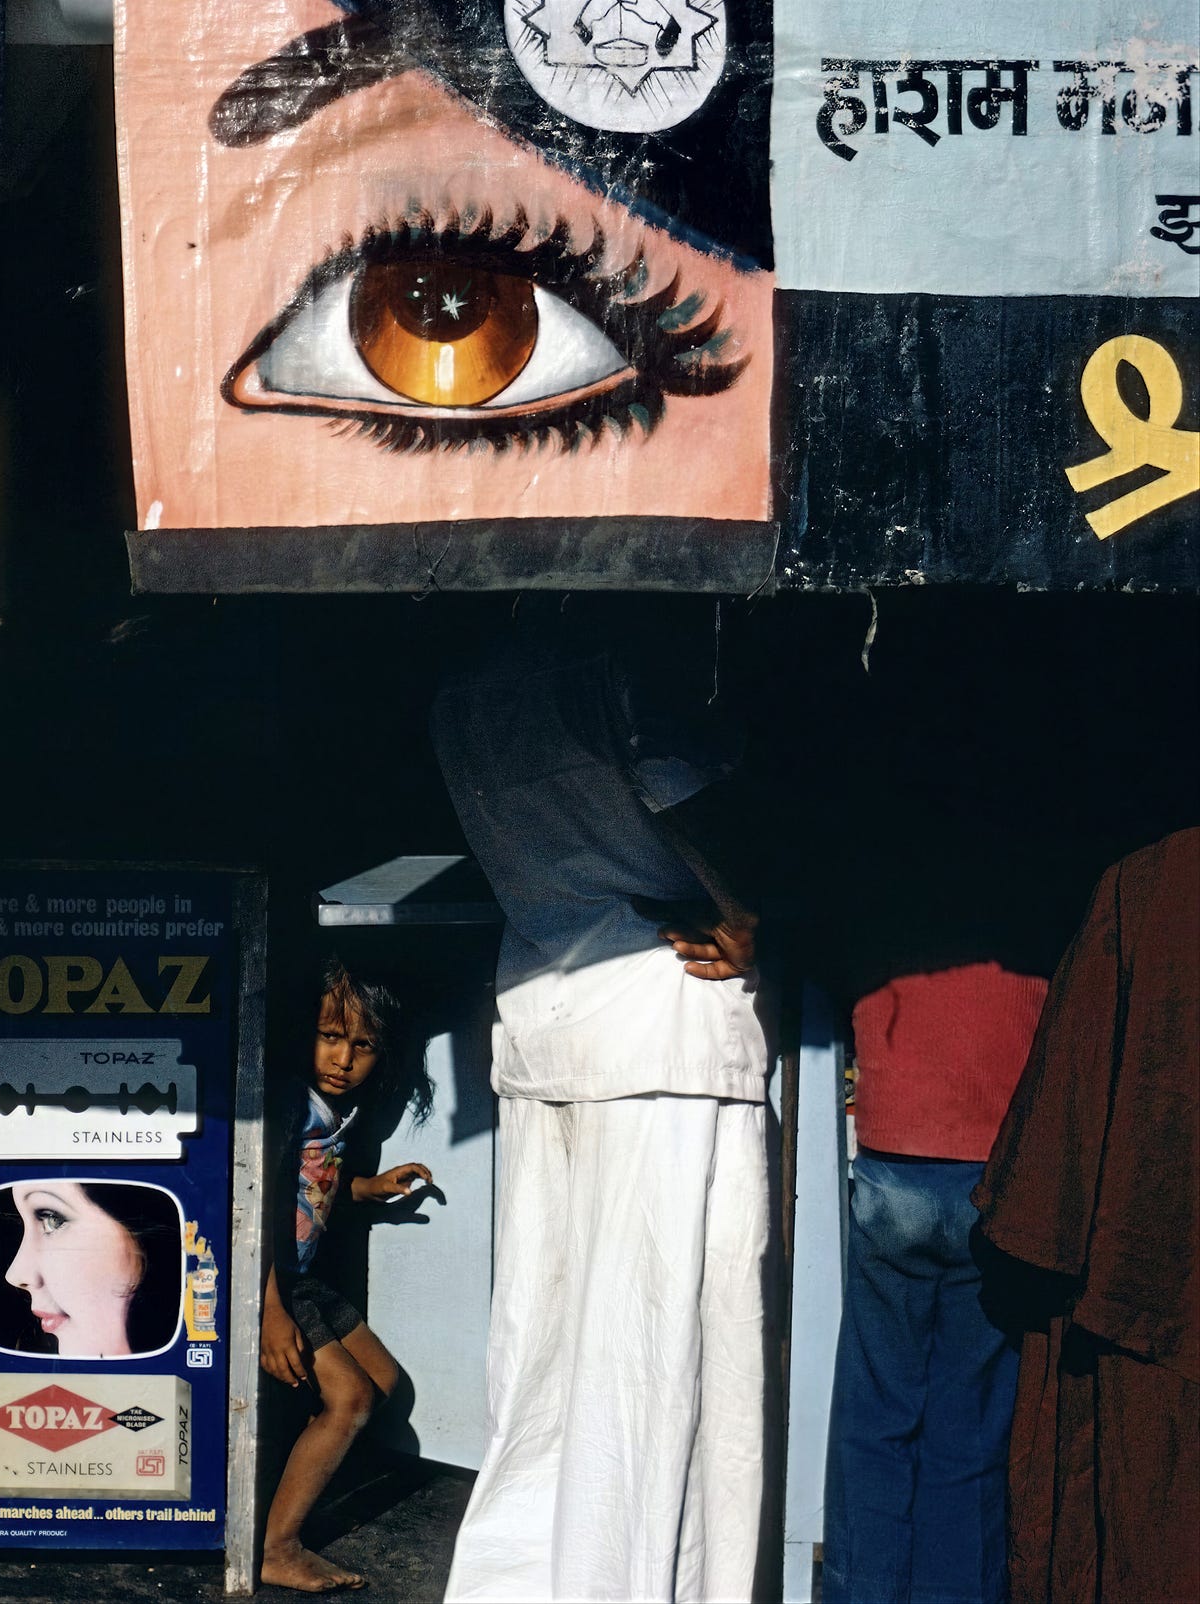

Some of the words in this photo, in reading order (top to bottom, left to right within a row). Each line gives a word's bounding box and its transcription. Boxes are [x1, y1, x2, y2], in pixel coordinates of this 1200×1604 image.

[24, 893, 40, 913] &
[47, 897, 97, 914] more
[105, 894, 166, 918] people
[174, 894, 192, 914] in
[13, 921, 65, 936] more
[71, 918, 159, 936] countries
[165, 918, 224, 940] prefer
[79, 1052, 155, 1064] TOPAZ
[72, 1131, 162, 1143] STAINLESS
[6, 1405, 103, 1430] TOPAZ
[178, 1405, 188, 1465] TOPAZ
[27, 1461, 113, 1476] STAINLESS
[0, 1506, 53, 1519] marches
[105, 1506, 144, 1520] others
[145, 1508, 172, 1521] trail
[174, 1508, 216, 1522] behind
